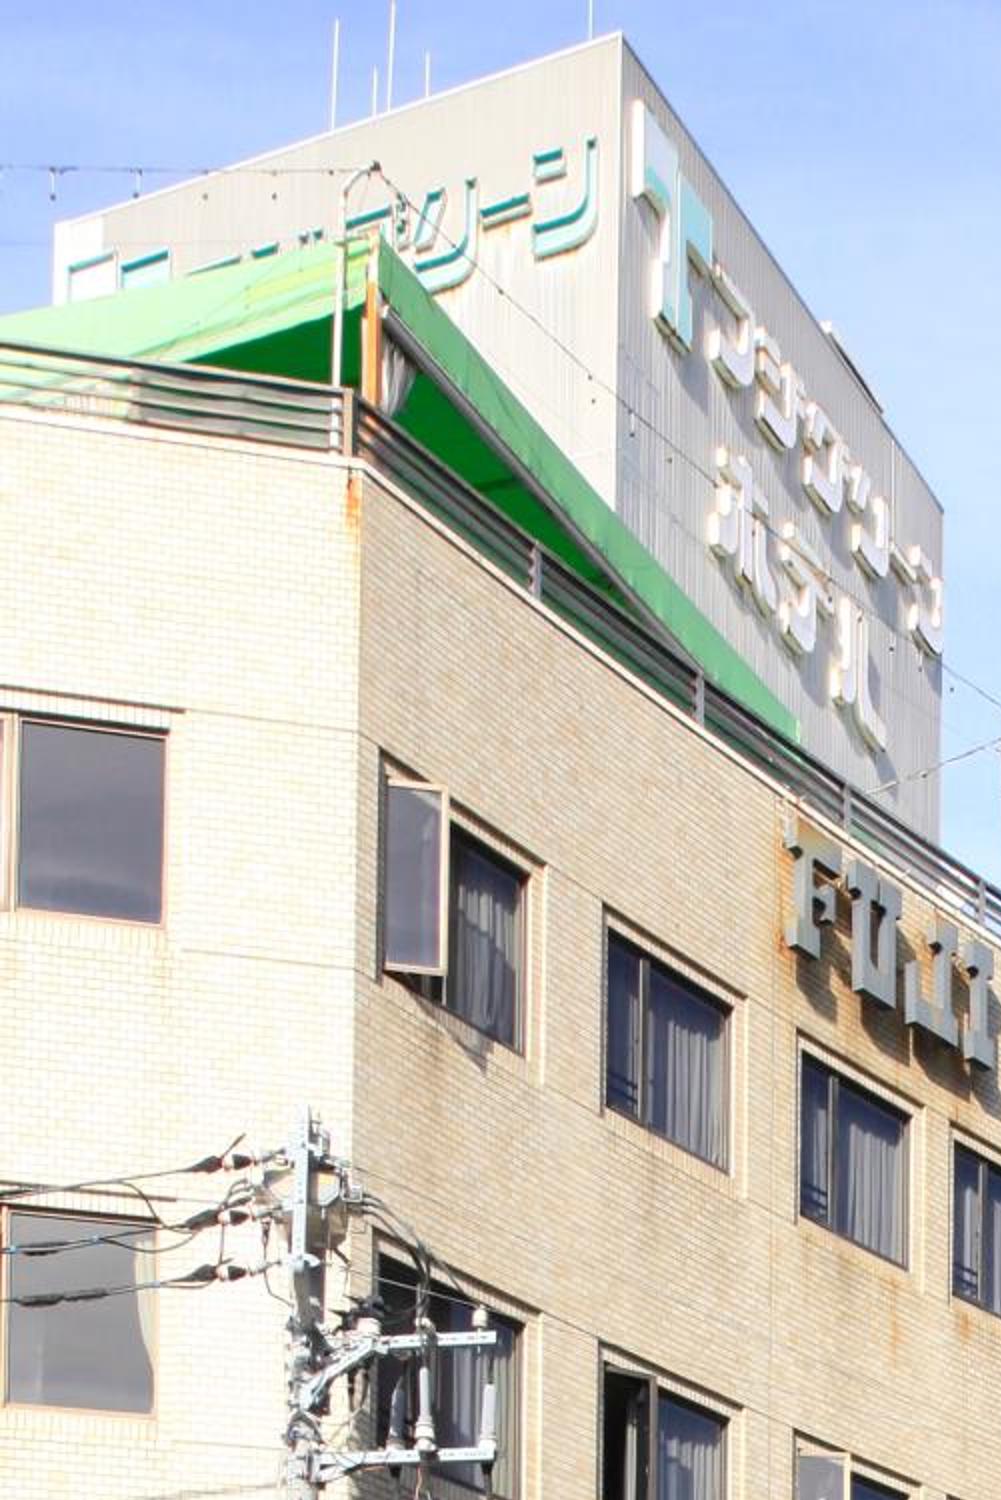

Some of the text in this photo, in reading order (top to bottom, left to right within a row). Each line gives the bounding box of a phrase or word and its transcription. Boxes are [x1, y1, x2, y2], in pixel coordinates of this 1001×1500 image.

[708, 446, 887, 754] ホテル
[784, 808, 995, 1071] FUJI
